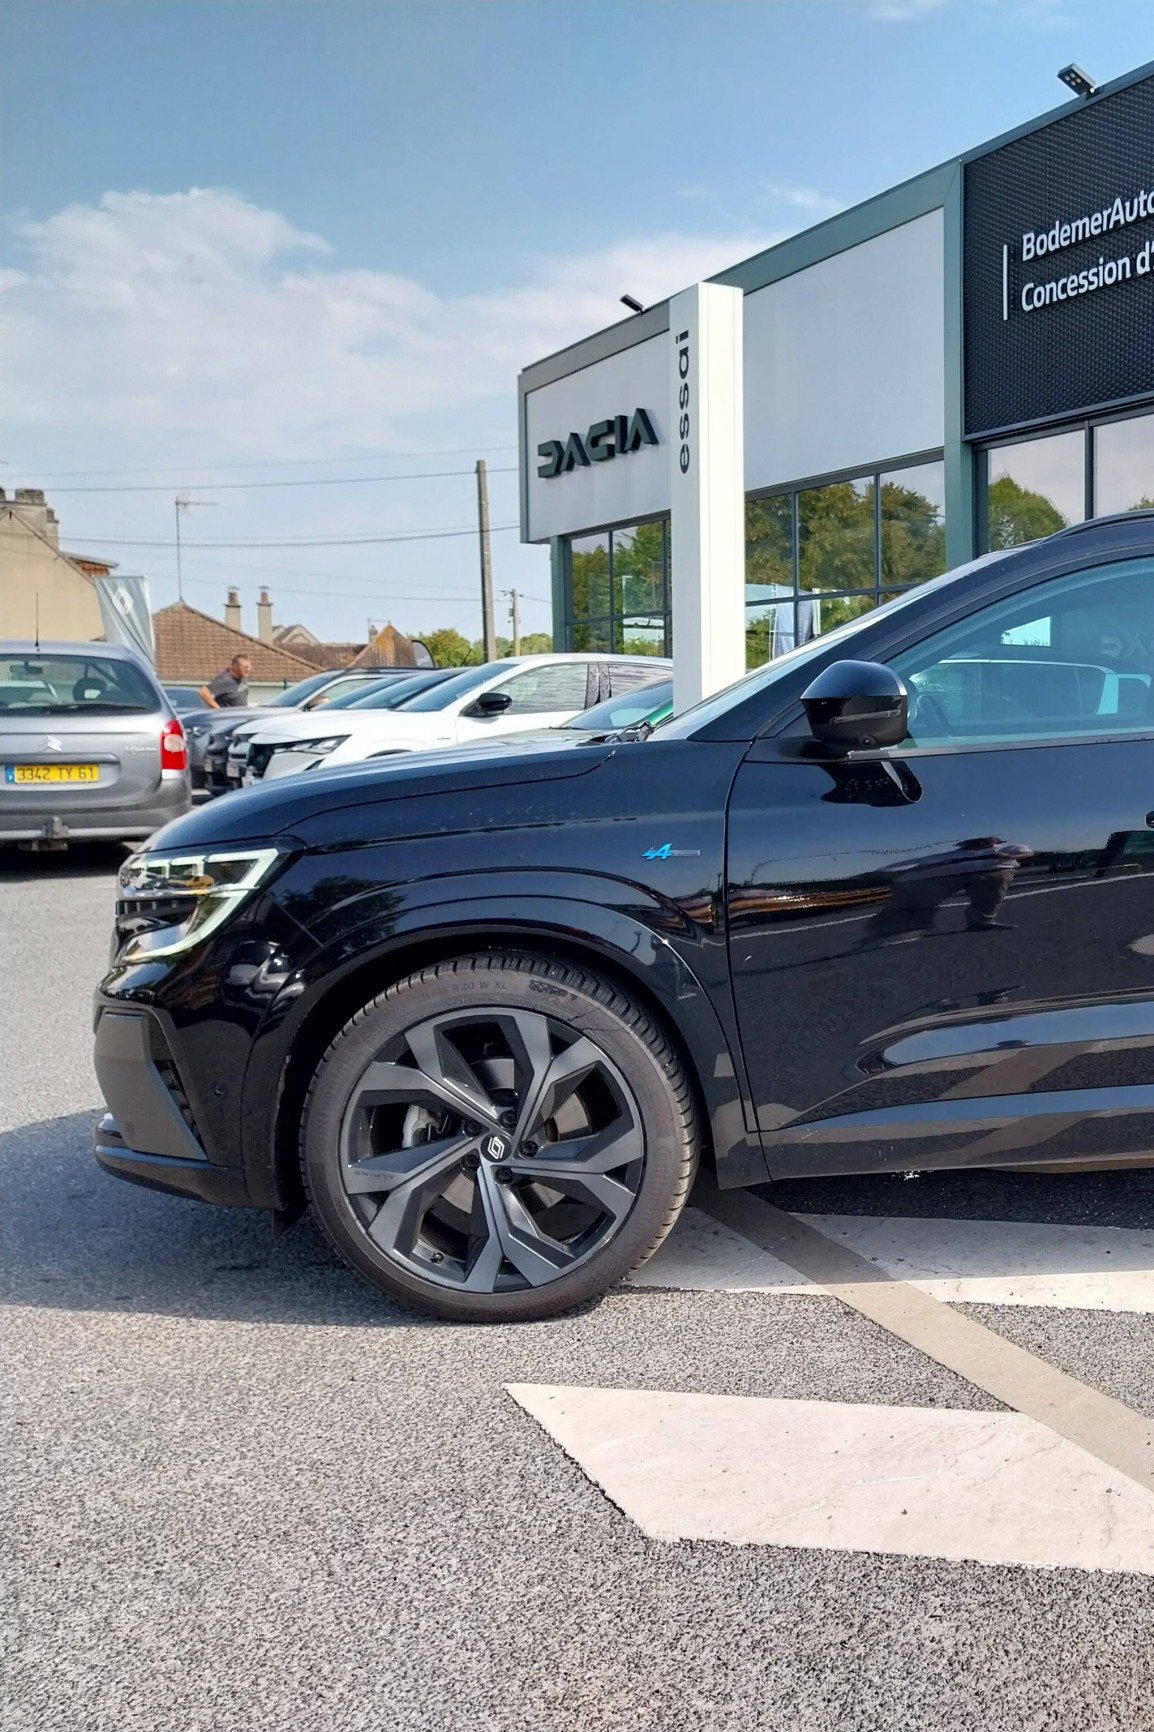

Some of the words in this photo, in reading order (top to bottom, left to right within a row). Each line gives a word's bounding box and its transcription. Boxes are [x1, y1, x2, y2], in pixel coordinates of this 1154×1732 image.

[1020, 257, 1132, 312] Concession
[675, 329, 690, 475] essai
[537, 407, 660, 479] DACIA
[17, 765, 50, 781] 3342
[58, 765, 75, 780] TY
[78, 765, 94, 780] 61
